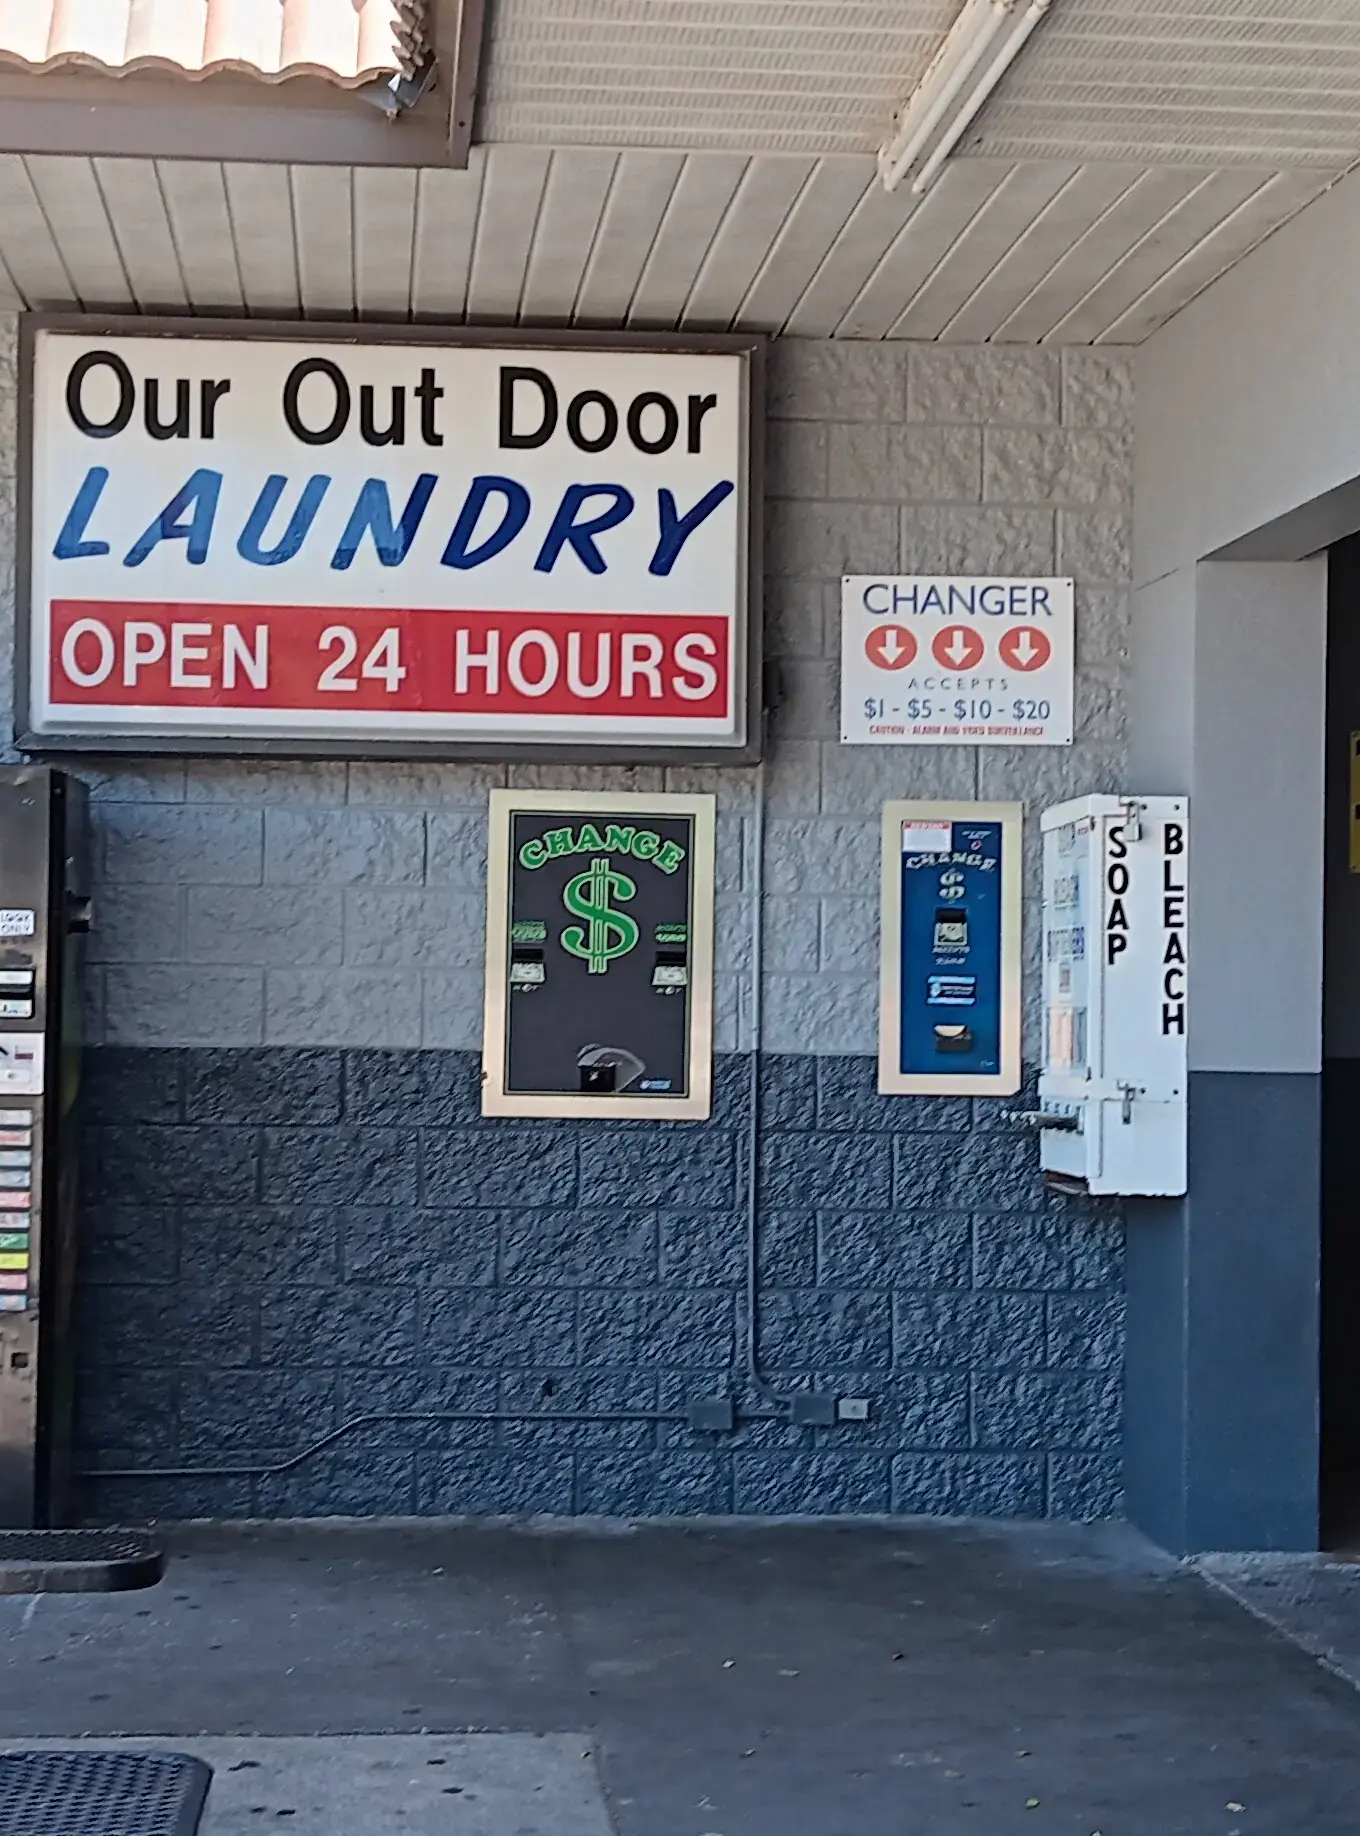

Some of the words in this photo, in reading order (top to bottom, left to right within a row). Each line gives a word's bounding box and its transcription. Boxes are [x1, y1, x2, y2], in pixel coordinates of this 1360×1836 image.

[66, 351, 231, 440] Our
[283, 357, 444, 447] Out
[498, 366, 717, 454] Door
[53, 466, 734, 576] LAUNDRY
[863, 583, 1053, 616] CHANGER
[61, 618, 269, 690] OPEN
[317, 626, 407, 693] 24
[454, 629, 718, 700] HOURS
[908, 677, 1009, 691] ACCEPTS
[863, 697, 884, 719] $1
[907, 698, 932, 719] $5
[953, 698, 992, 720] $10
[1012, 698, 1051, 720] $20
[519, 823, 686, 875] CHANGE
[1106, 825, 1130, 966] SOAP
[1161, 823, 1186, 1036] BLEACH
